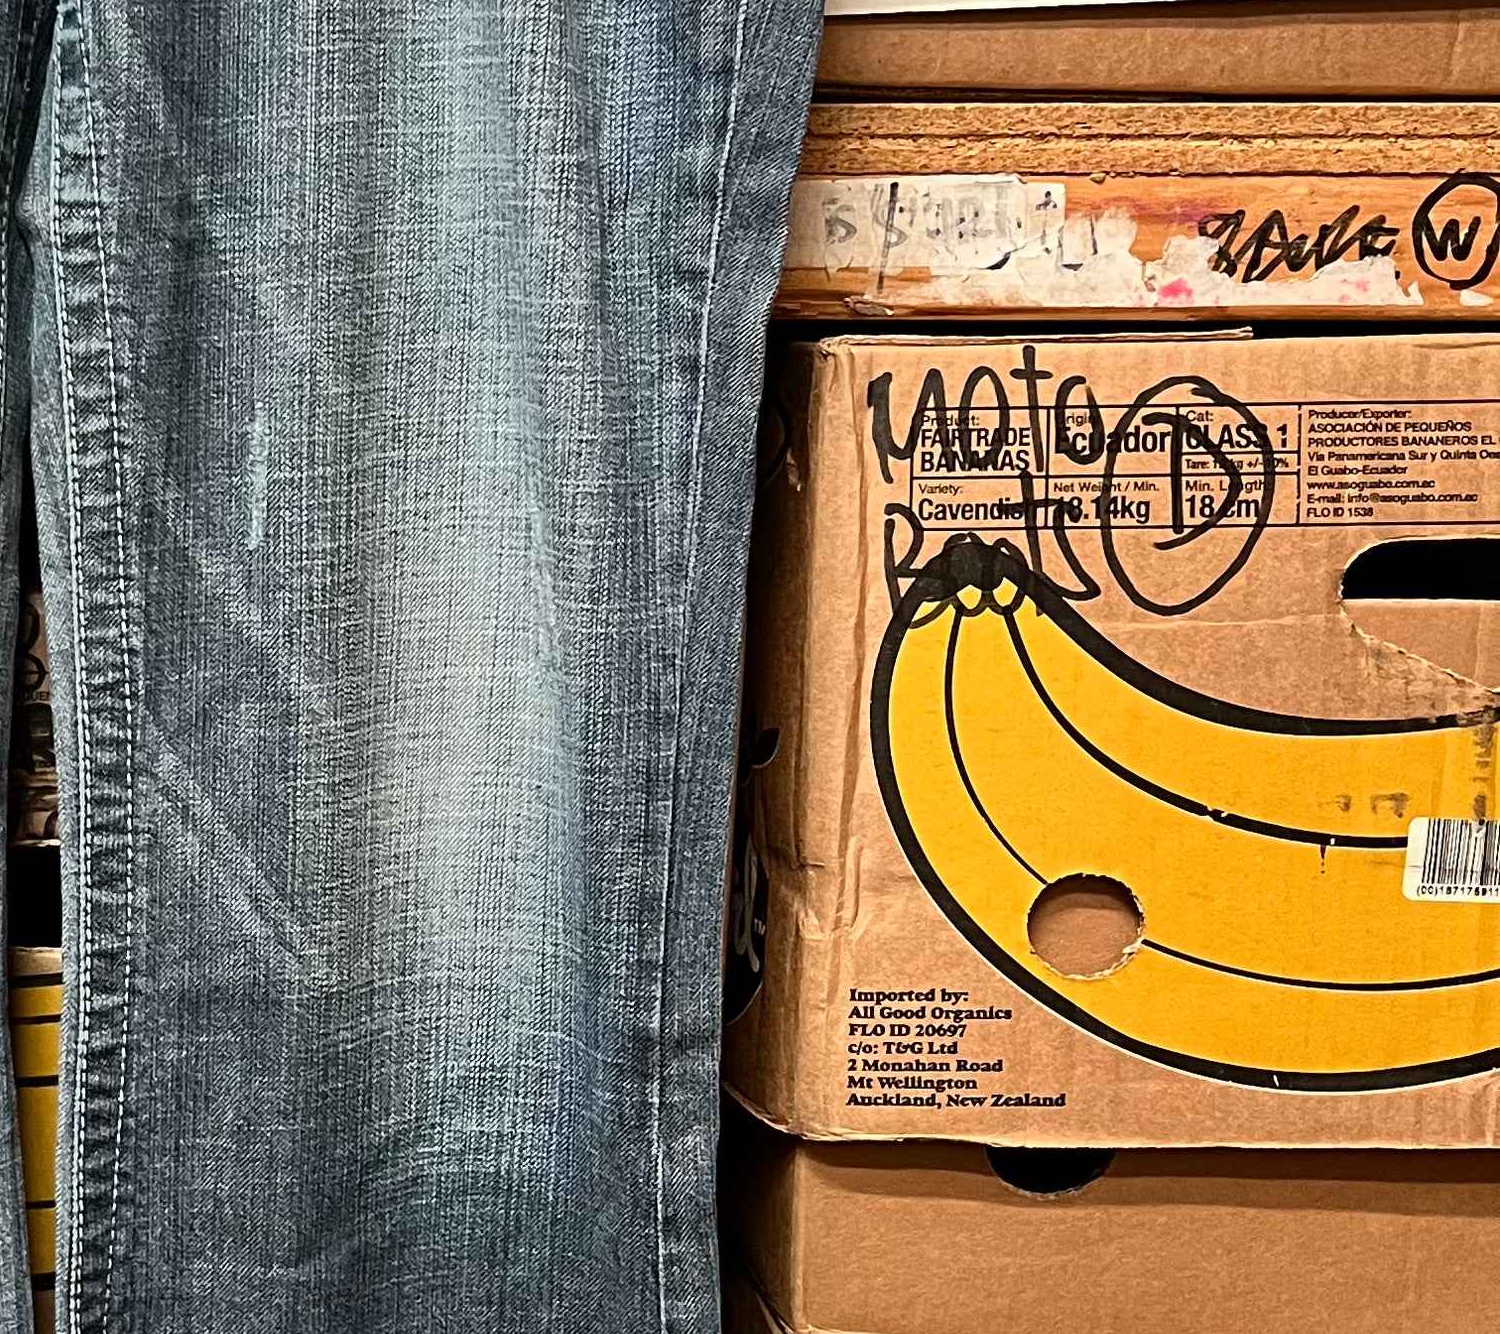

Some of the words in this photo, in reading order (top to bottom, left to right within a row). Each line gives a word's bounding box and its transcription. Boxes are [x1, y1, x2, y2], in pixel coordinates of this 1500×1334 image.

[921, 428, 1030, 447] FAIRTRADE
[1308, 437, 1398, 447] PRODUCTORES
[1402, 436, 1478, 446] BANANEROS
[919, 482, 962, 495] Variety:
[850, 988, 935, 1005] Imported
[941, 988, 968, 1005] by:
[849, 1006, 875, 1019] All
[880, 1006, 926, 1019] Good
[931, 1006, 1012, 1023] Organics
[849, 1024, 885, 1037] FLO
[915, 1024, 967, 1037] 20697
[928, 1041, 958, 1054] Ltd
[862, 1059, 950, 1072] Monahan
[956, 1059, 1003, 1072] Road
[877, 1076, 977, 1092] Wellington
[846, 1093, 942, 1109] Auckland,
[946, 1094, 987, 1107] New
[991, 1093, 1066, 1107] Zealand
